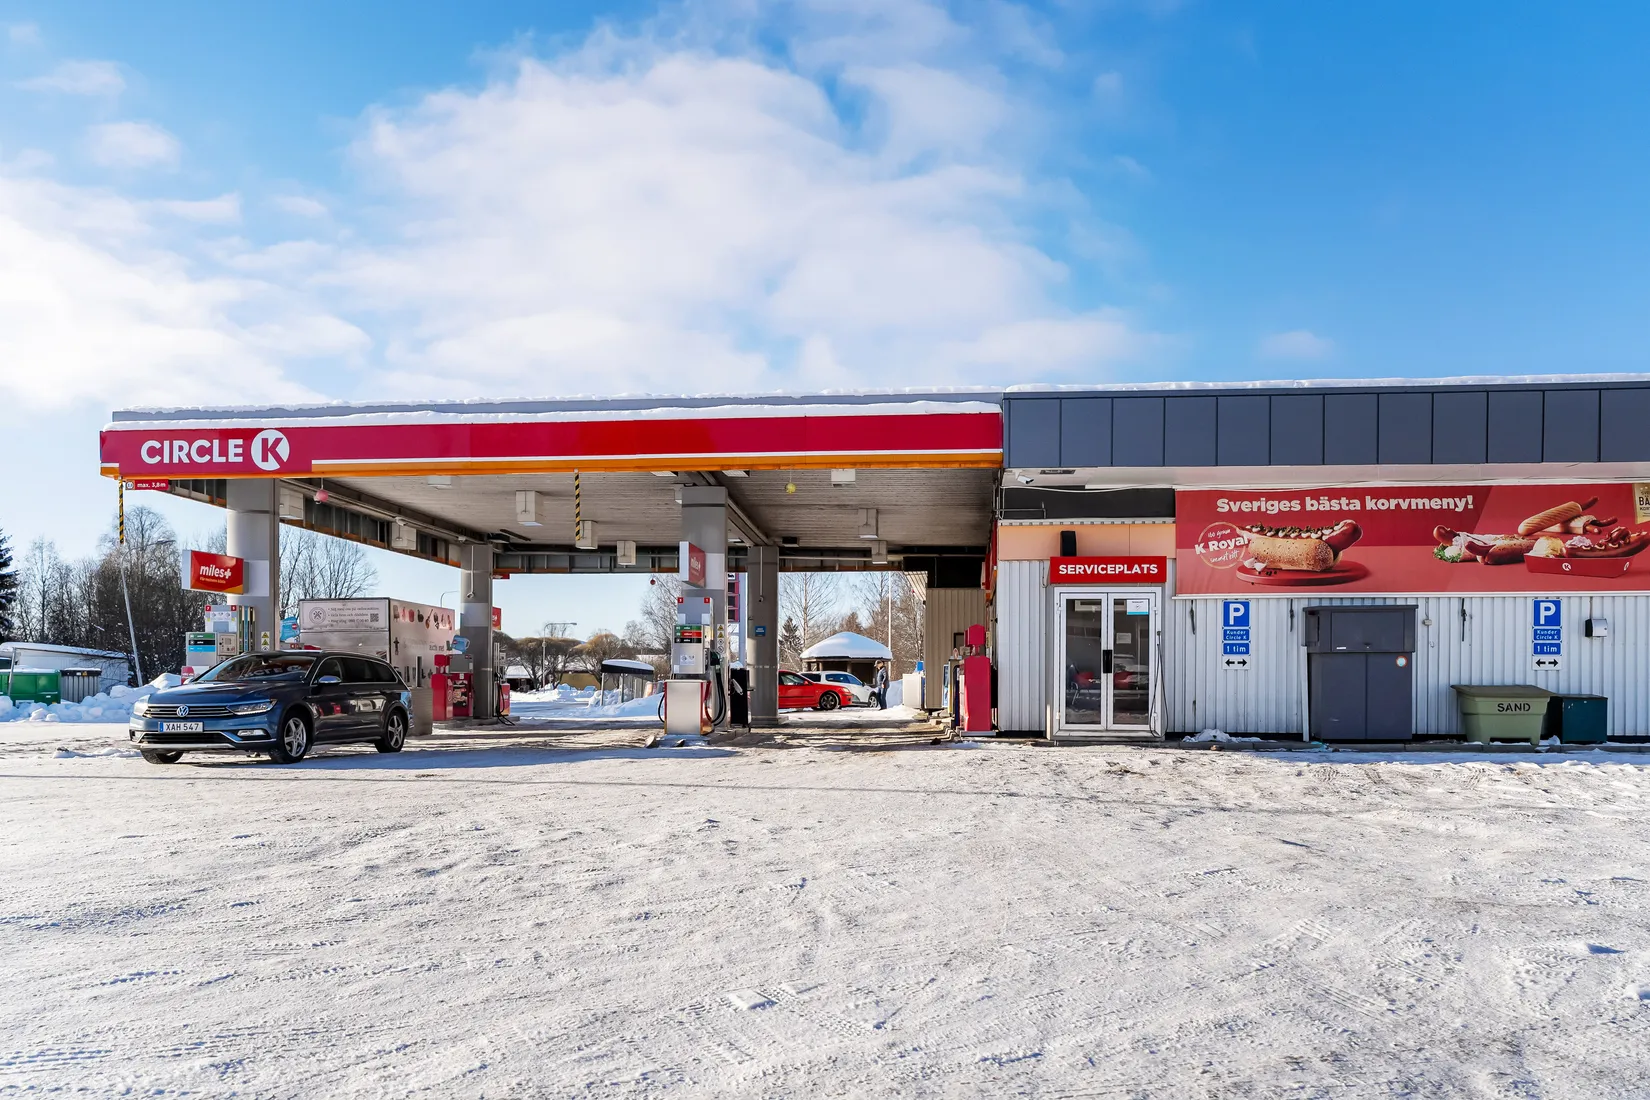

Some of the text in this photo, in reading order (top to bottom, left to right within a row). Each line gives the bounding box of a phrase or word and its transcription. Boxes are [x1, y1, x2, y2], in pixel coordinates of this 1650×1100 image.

[140, 430, 290, 471] CIRCLE K
[1216, 495, 1474, 515] Sveriges bästa korvmeny!
[1194, 533, 1249, 555] K Royal
[1058, 564, 1158, 575] SERVICEPLATS
[1229, 603, 1245, 625] P
[1539, 602, 1556, 625] P
[1226, 645, 1247, 653] 1 tim
[1543, 645, 1558, 653] tim
[1497, 702, 1531, 712] SAND
[165, 723, 200, 731] XAH 547
